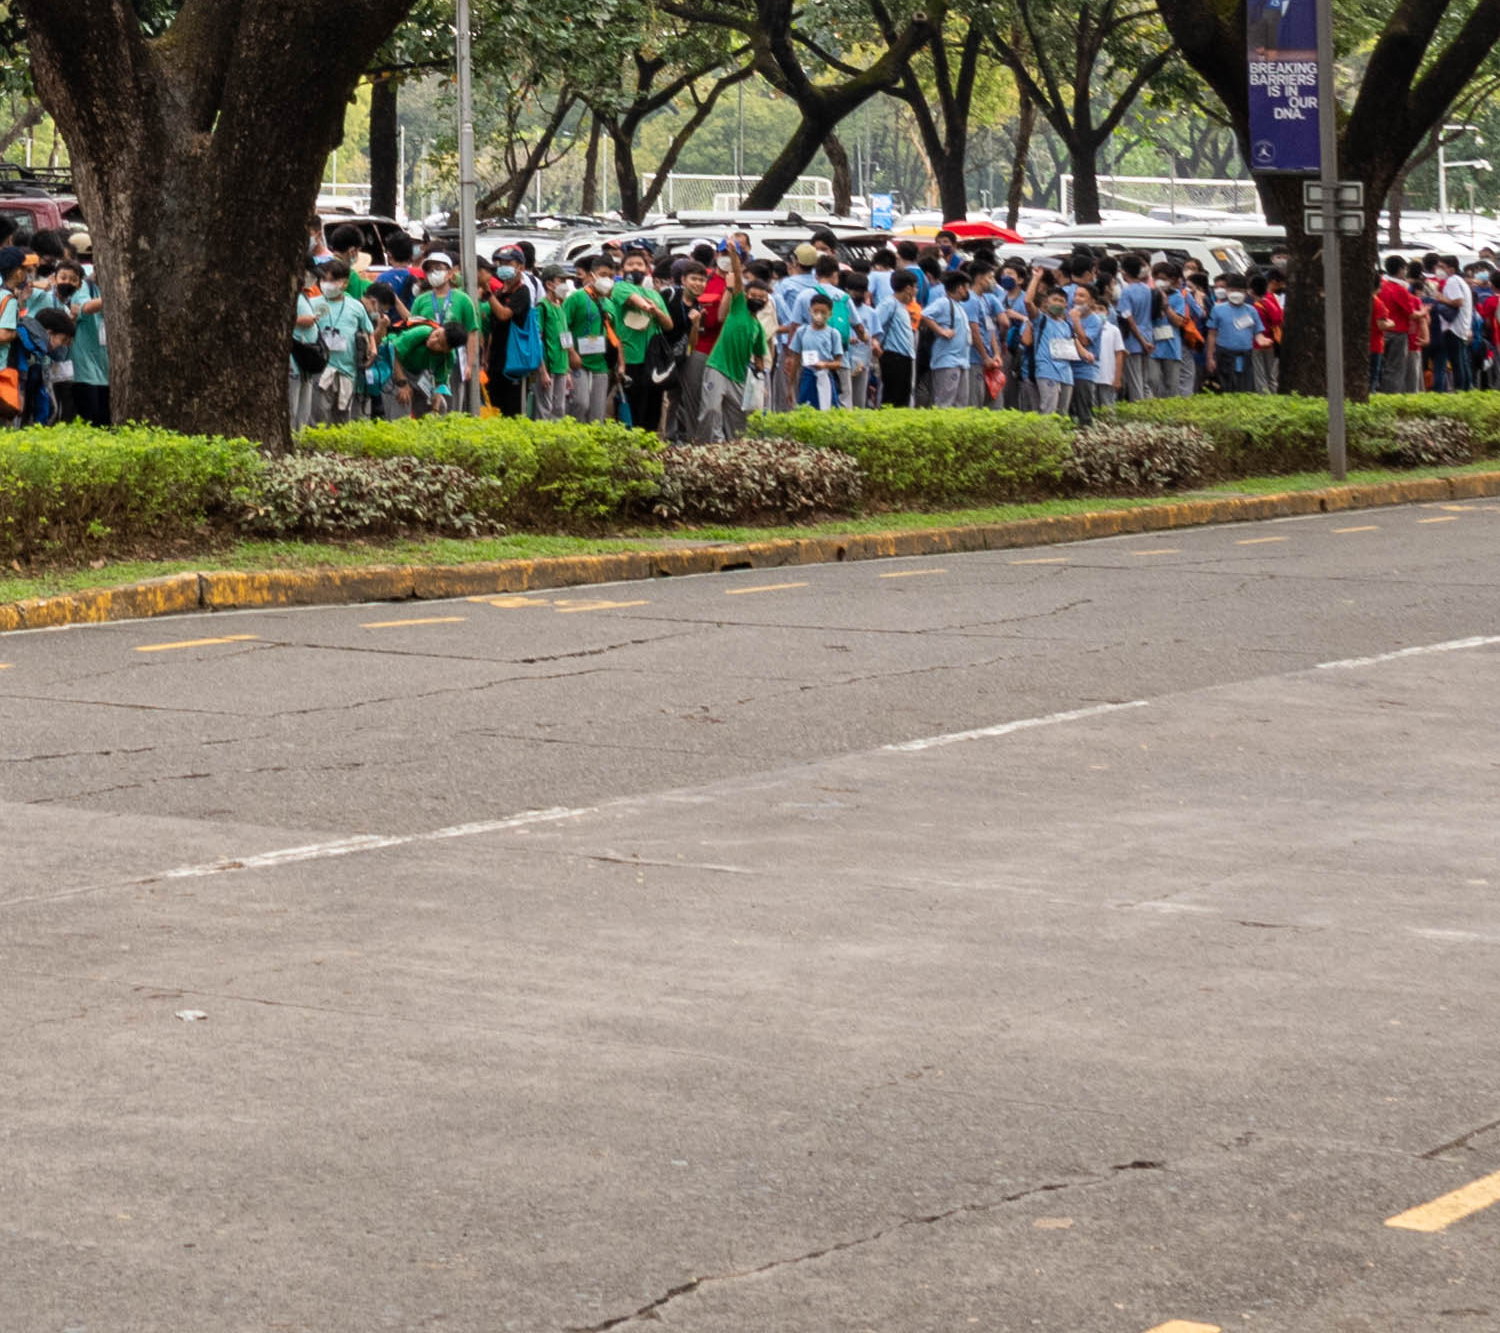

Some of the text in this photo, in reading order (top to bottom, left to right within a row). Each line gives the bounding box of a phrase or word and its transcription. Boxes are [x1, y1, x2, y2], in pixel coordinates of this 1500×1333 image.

[1249, 62, 1318, 74] BREAKING
[1250, 74, 1316, 86] BARRIERS
[1267, 85, 1298, 97] IS IN
[1288, 96, 1318, 109] OUR
[1273, 107, 1306, 120] DNA.
